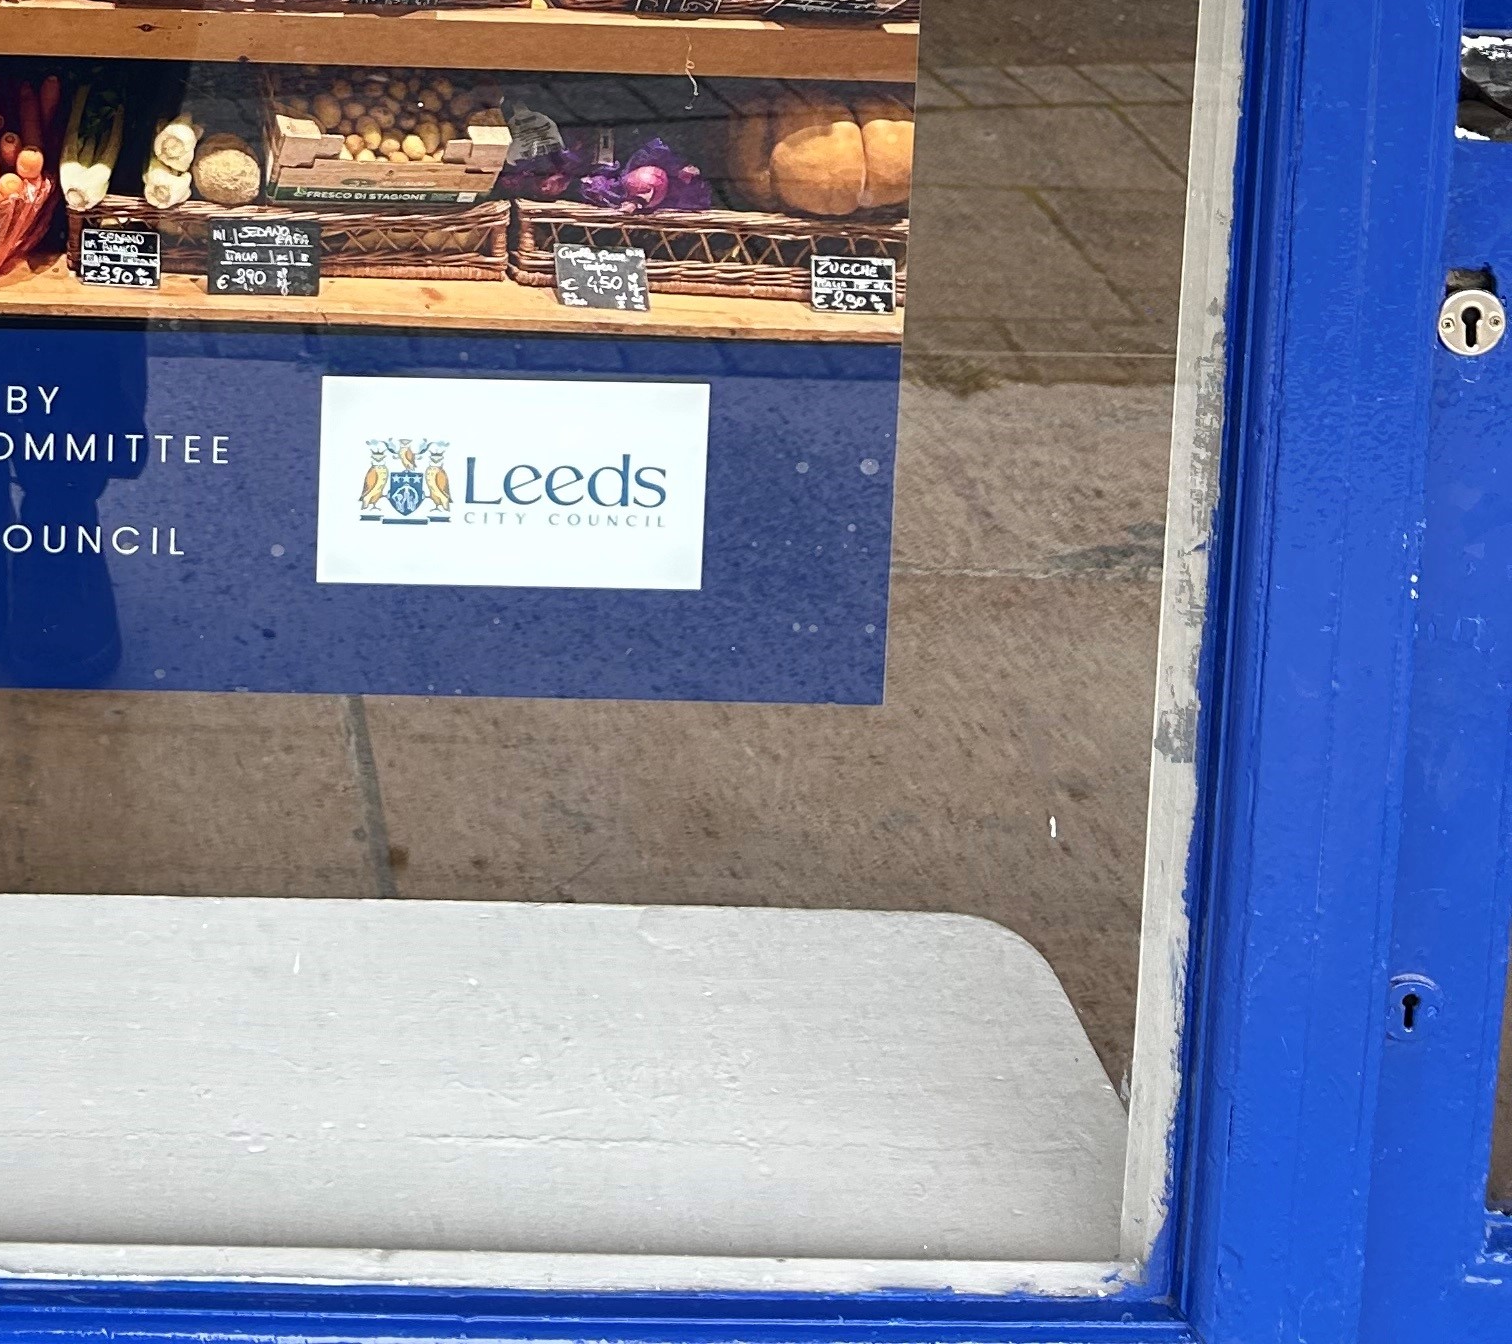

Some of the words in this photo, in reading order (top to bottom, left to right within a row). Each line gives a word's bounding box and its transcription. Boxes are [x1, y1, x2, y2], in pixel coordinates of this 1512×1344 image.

[306, 191, 353, 200] FRESCO
[354, 192, 366, 200] DI
[369, 192, 427, 201] STAGIONE
[816, 261, 879, 278] ZUCCHE
[216, 274, 230, 290] €
[6, 385, 62, 417] BY
[464, 453, 667, 509] Leeds
[463, 512, 527, 526] CITY
[548, 513, 666, 529] COUNCIL
